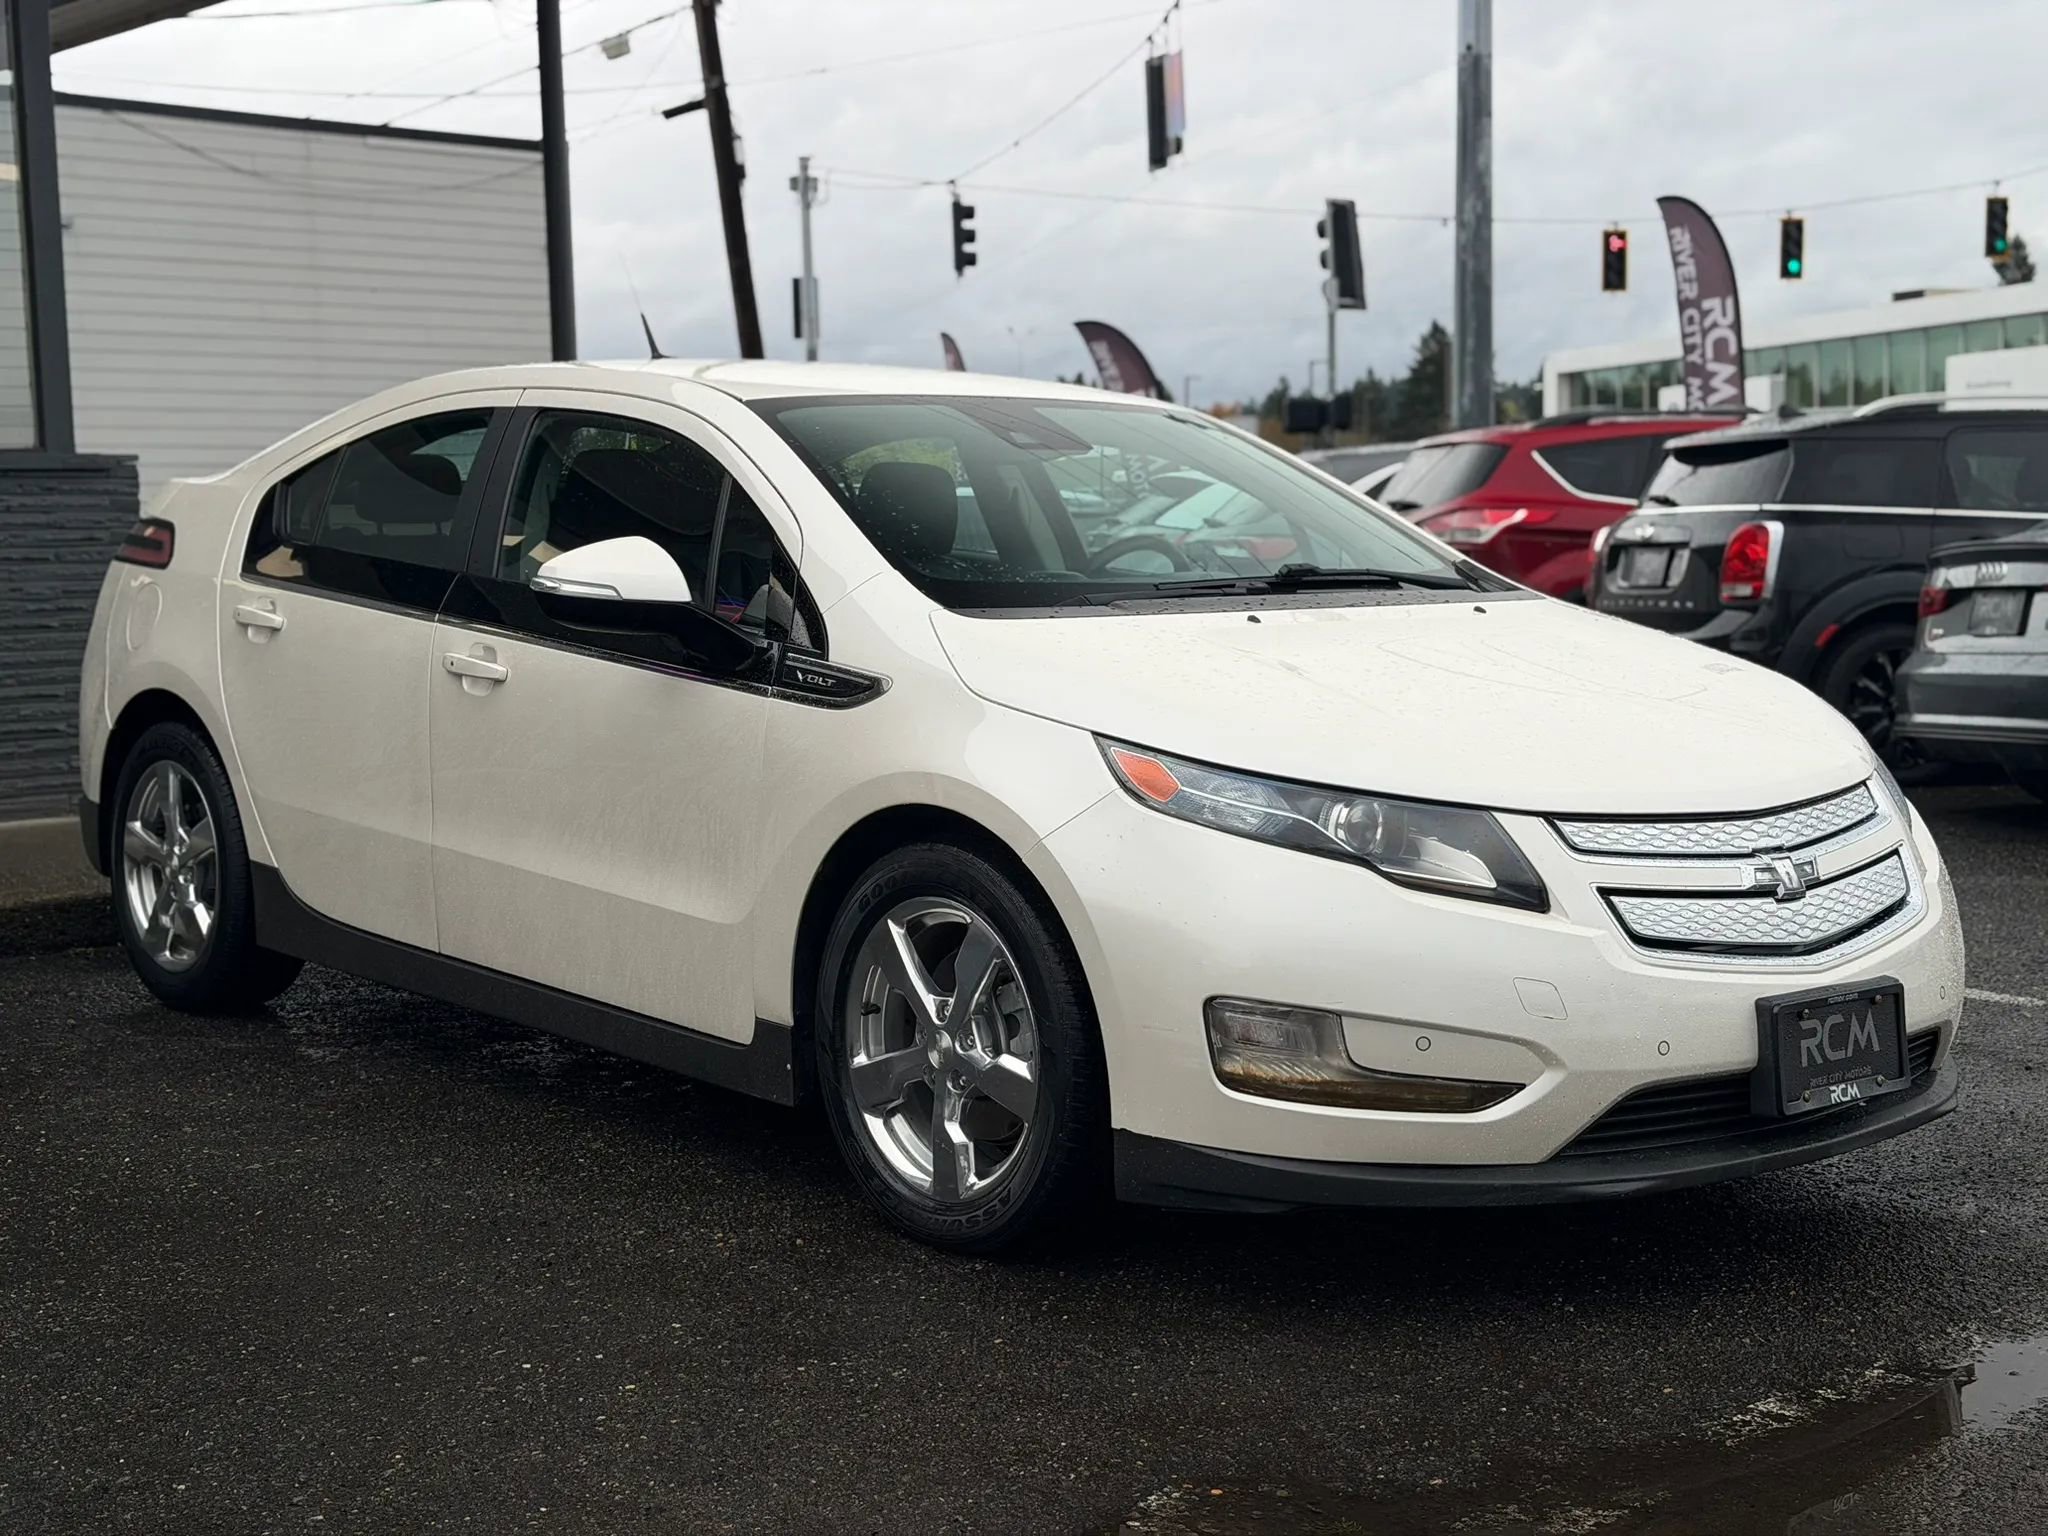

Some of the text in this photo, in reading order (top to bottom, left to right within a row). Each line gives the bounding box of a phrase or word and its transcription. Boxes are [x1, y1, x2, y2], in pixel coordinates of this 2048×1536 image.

[1669, 225, 1699, 301] RIVER
[1682, 307, 1704, 366] CITY
[1701, 295, 1739, 406] RCM
[796, 669, 837, 687] VOLT
[1800, 1008, 1881, 1068] RCM
[1809, 1064, 1873, 1087] RIVER CITY MOTORS
[1829, 1082, 1861, 1104] RCM
